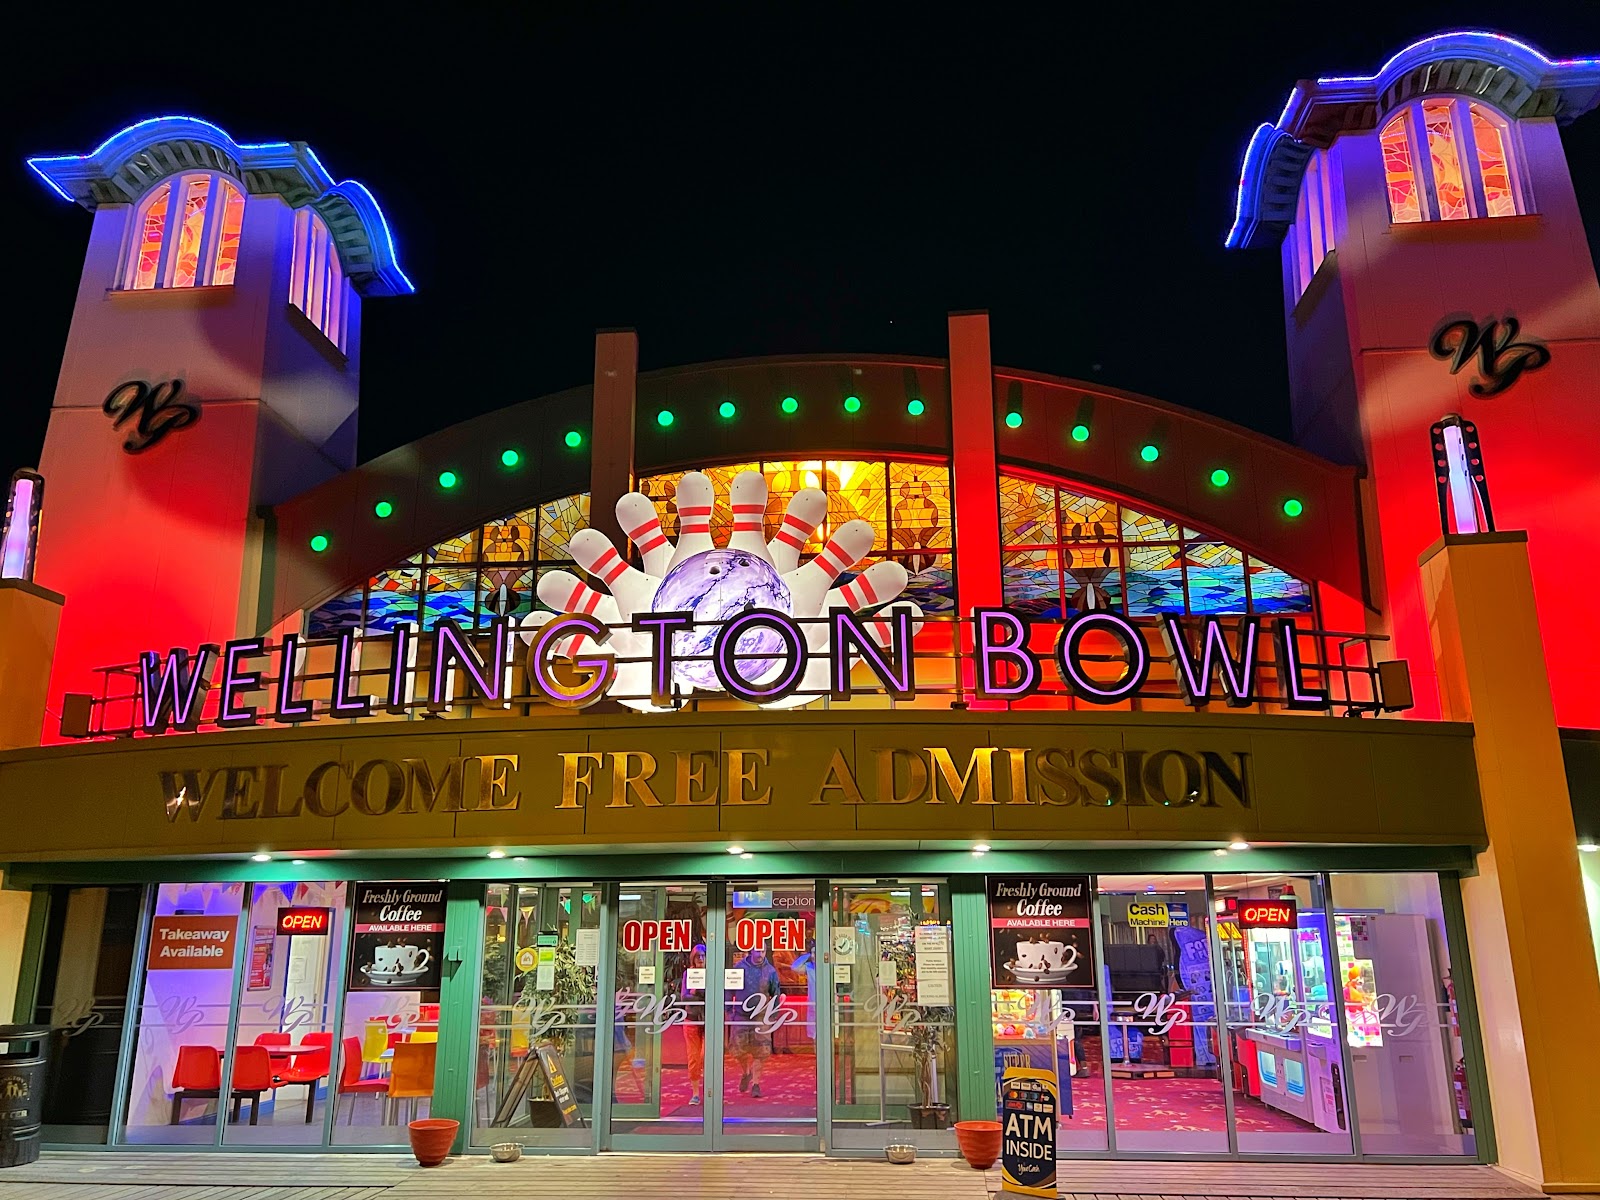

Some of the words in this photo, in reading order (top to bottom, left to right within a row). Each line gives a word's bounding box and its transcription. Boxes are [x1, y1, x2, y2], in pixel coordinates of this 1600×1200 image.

[138, 605, 914, 732] WELLINGTON
[975, 607, 1329, 709] BOWL
[159, 754, 520, 822] WELCOME
[555, 748, 773, 811] FREE
[814, 746, 1251, 809] ADMISSION
[362, 889, 401, 906] Freshly
[402, 889, 443, 903] Ground
[996, 882, 1037, 899] Freshly
[1039, 882, 1082, 897] Ground
[772, 895, 815, 909] ception
[1016, 899, 1063, 916] Coffee
[1129, 903, 1165, 916] Cash
[281, 915, 323, 929] OPEN
[379, 905, 423, 922] Coffee
[1130, 918, 1166, 926] Machine
[1169, 918, 1189, 926] Here
[1244, 907, 1291, 922] OPEN
[369, 924, 410, 932] AVAILABLE
[411, 924, 433, 932] HERE
[1007, 919, 1050, 927] AVAILABLE
[1052, 919, 1075, 927] HERE
[160, 928, 230, 942] Takeaway
[623, 919, 692, 953] OPEN
[736, 919, 806, 952] OPEN
[160, 945, 224, 957] Available
[1005, 1112, 1053, 1141] ATM
[1006, 1139, 1053, 1161] INSIDE
